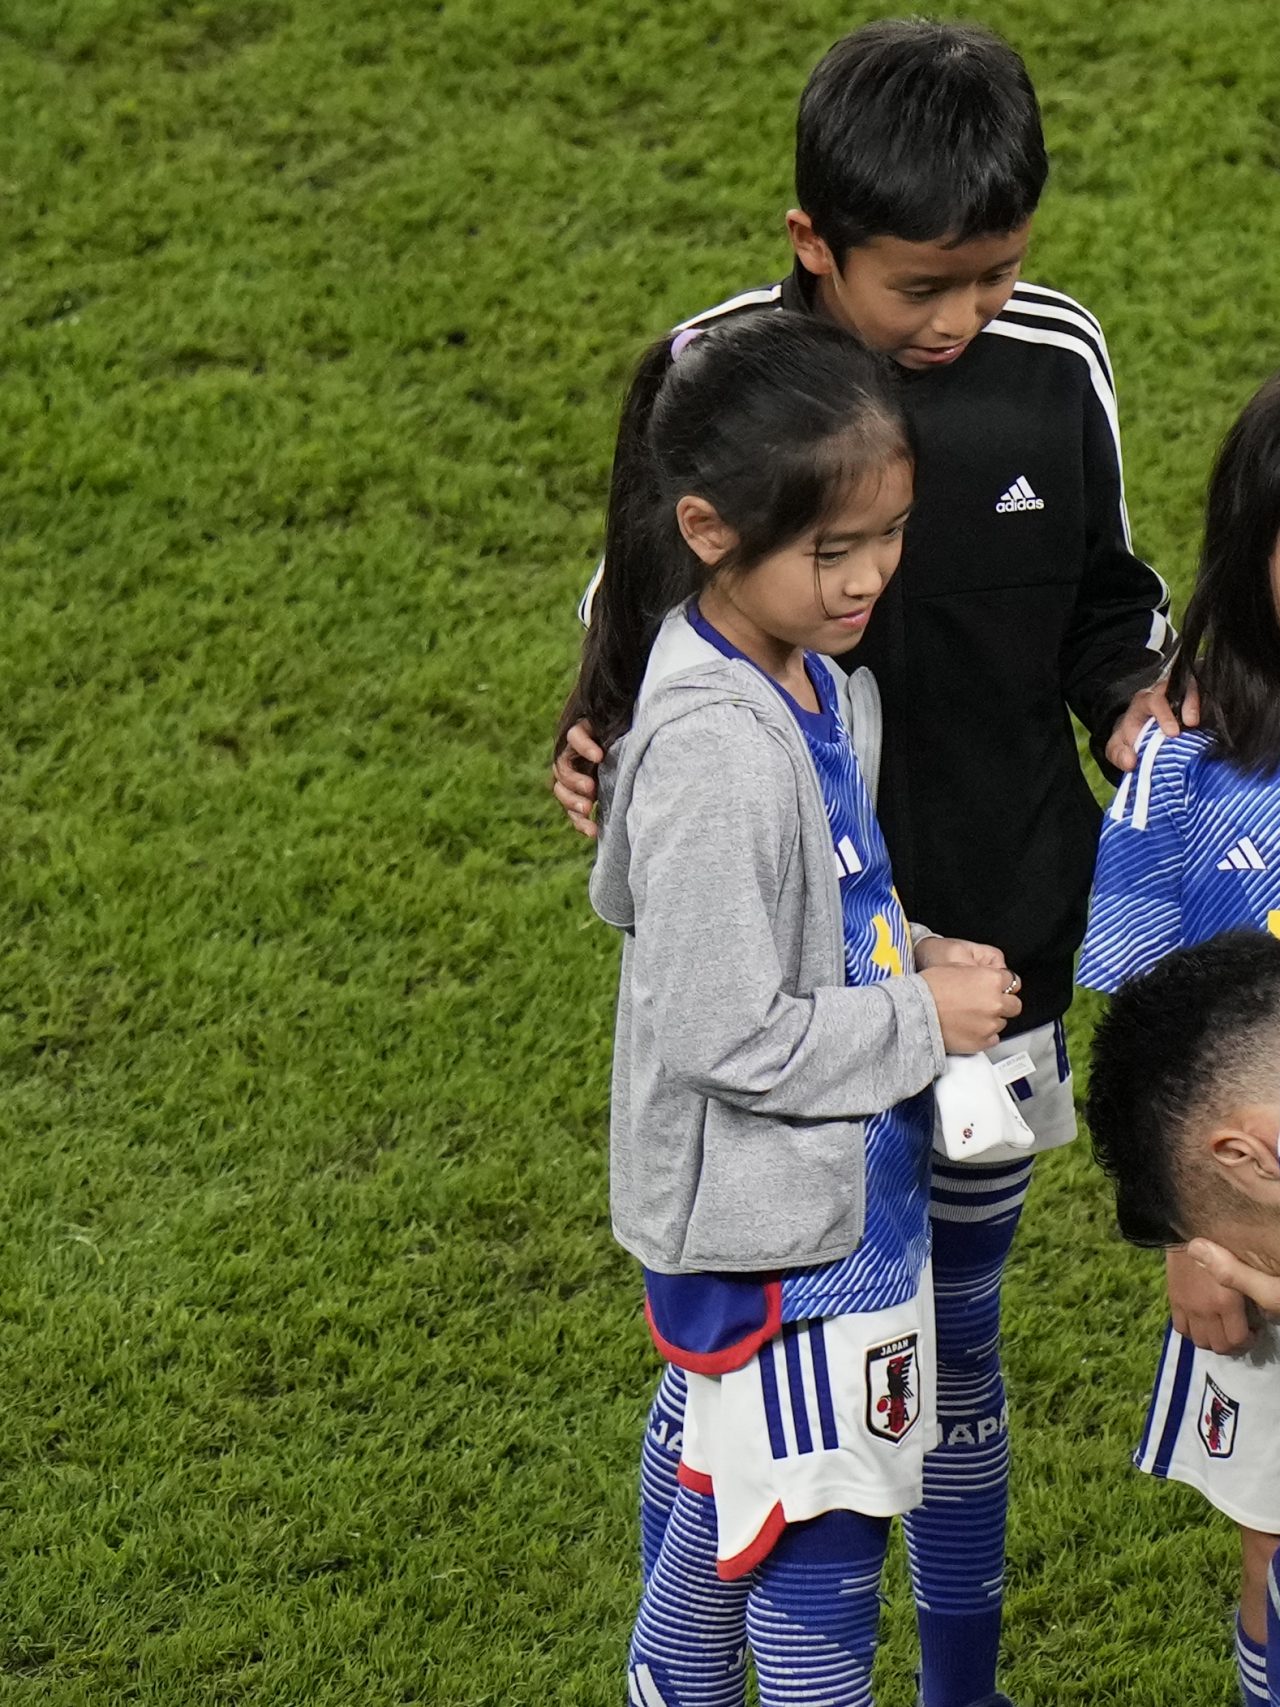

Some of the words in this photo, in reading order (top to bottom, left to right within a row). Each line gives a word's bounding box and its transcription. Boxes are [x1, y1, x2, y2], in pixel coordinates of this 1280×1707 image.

[996, 498, 1045, 513] adidas
[880, 1338, 909, 1356] JAPAN
[883, 1407, 910, 1428] JA
